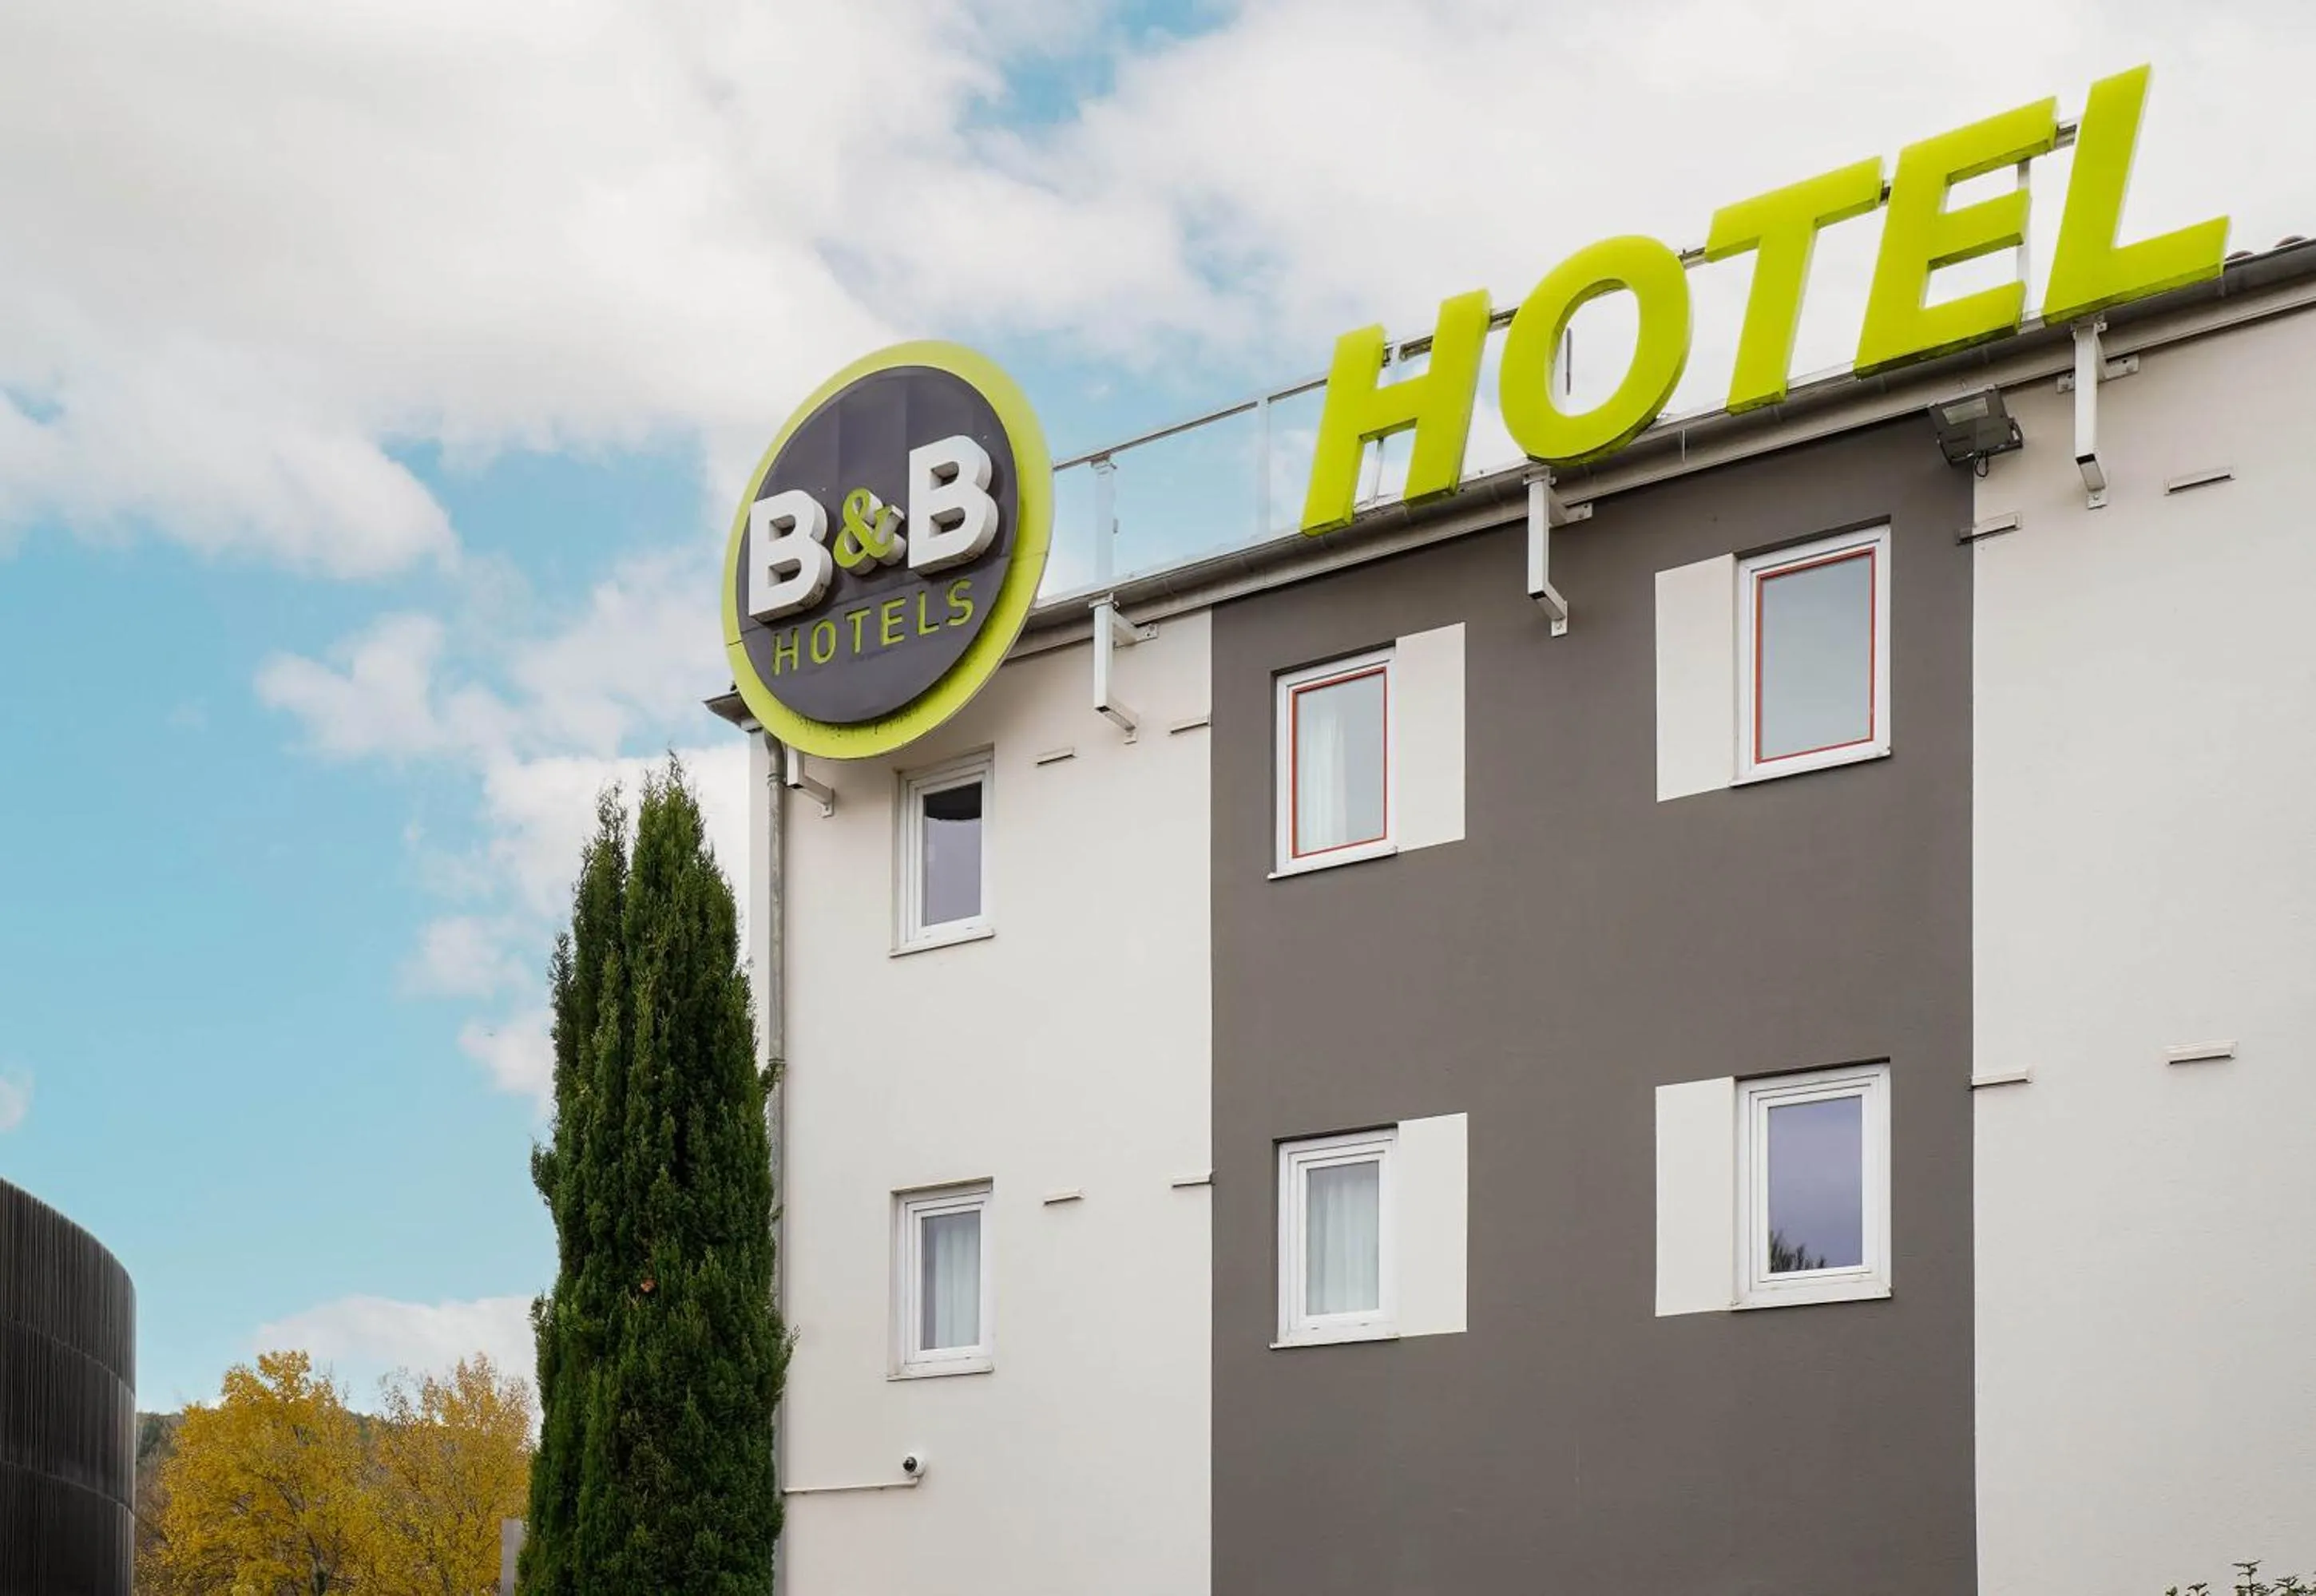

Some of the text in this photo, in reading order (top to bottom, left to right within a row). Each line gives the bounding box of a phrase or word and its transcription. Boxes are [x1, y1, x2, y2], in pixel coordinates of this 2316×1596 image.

[1300, 63, 2230, 537] HOTEL
[748, 434, 999, 622] B&B
[771, 578, 975, 676] HOTELS
